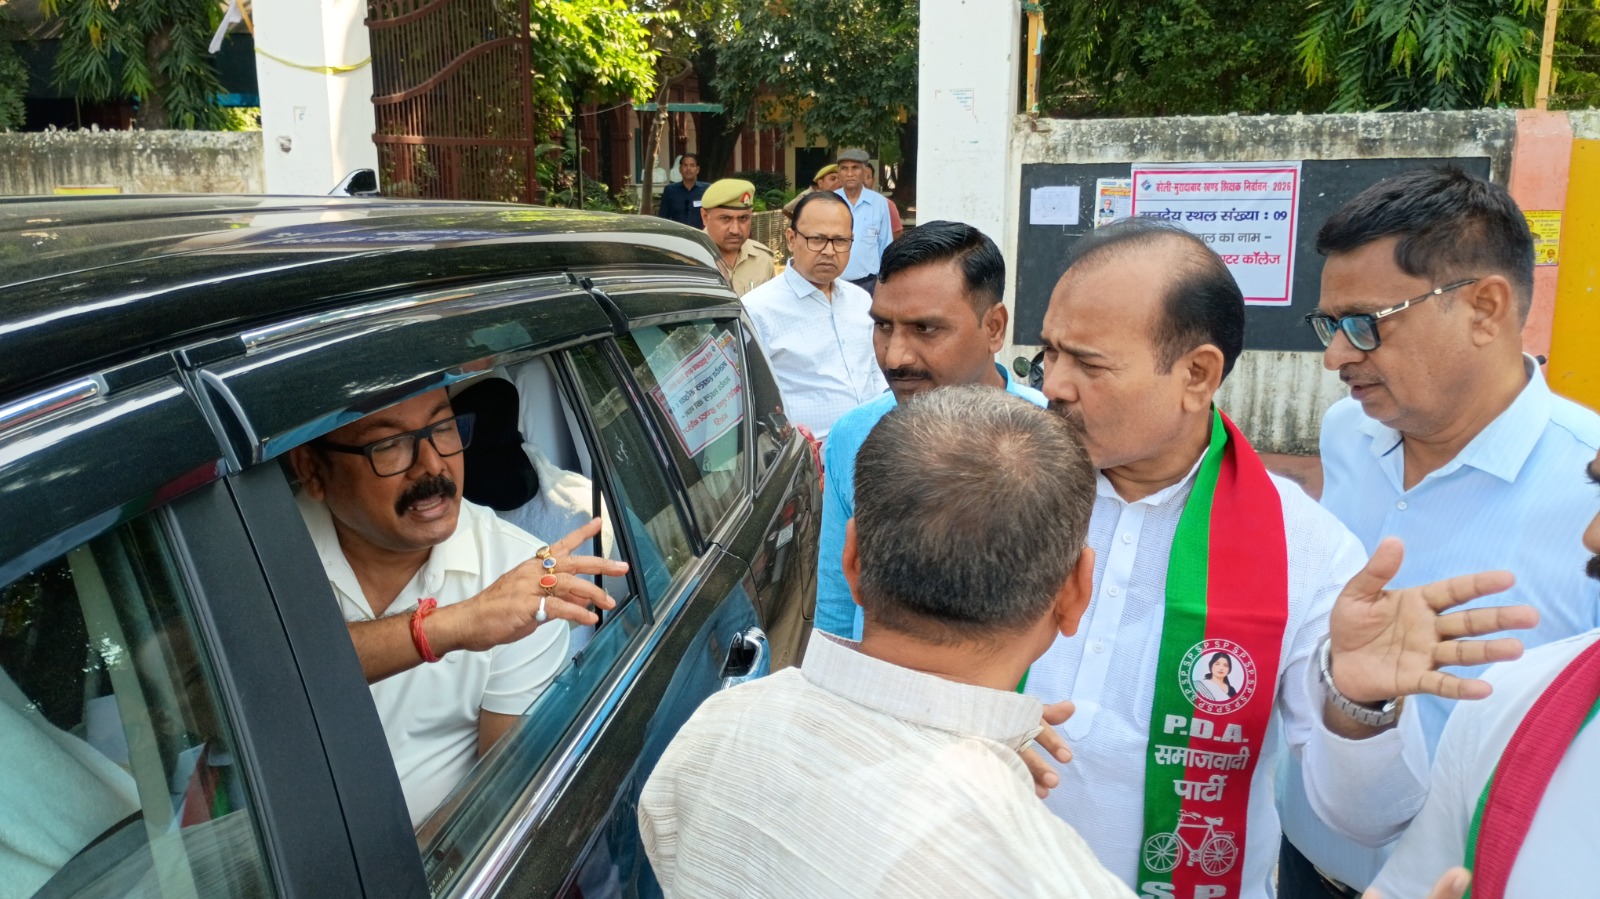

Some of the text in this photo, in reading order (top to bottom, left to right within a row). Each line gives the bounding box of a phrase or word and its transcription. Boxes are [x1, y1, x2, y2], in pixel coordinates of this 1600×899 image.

[1272, 181, 1291, 191] 2026
[1185, 210, 1217, 221] स्थल
[1220, 207, 1260, 221] संख्या
[1273, 210, 1288, 220] 09
[1219, 232, 1235, 243] का
[1237, 232, 1261, 243] नाम
[1242, 251, 1281, 265] कॉलेज
[1163, 714, 1249, 742] P.D.A.
[1154, 744, 1250, 770] समाजवादी
[1172, 774, 1228, 802] पार्टी
